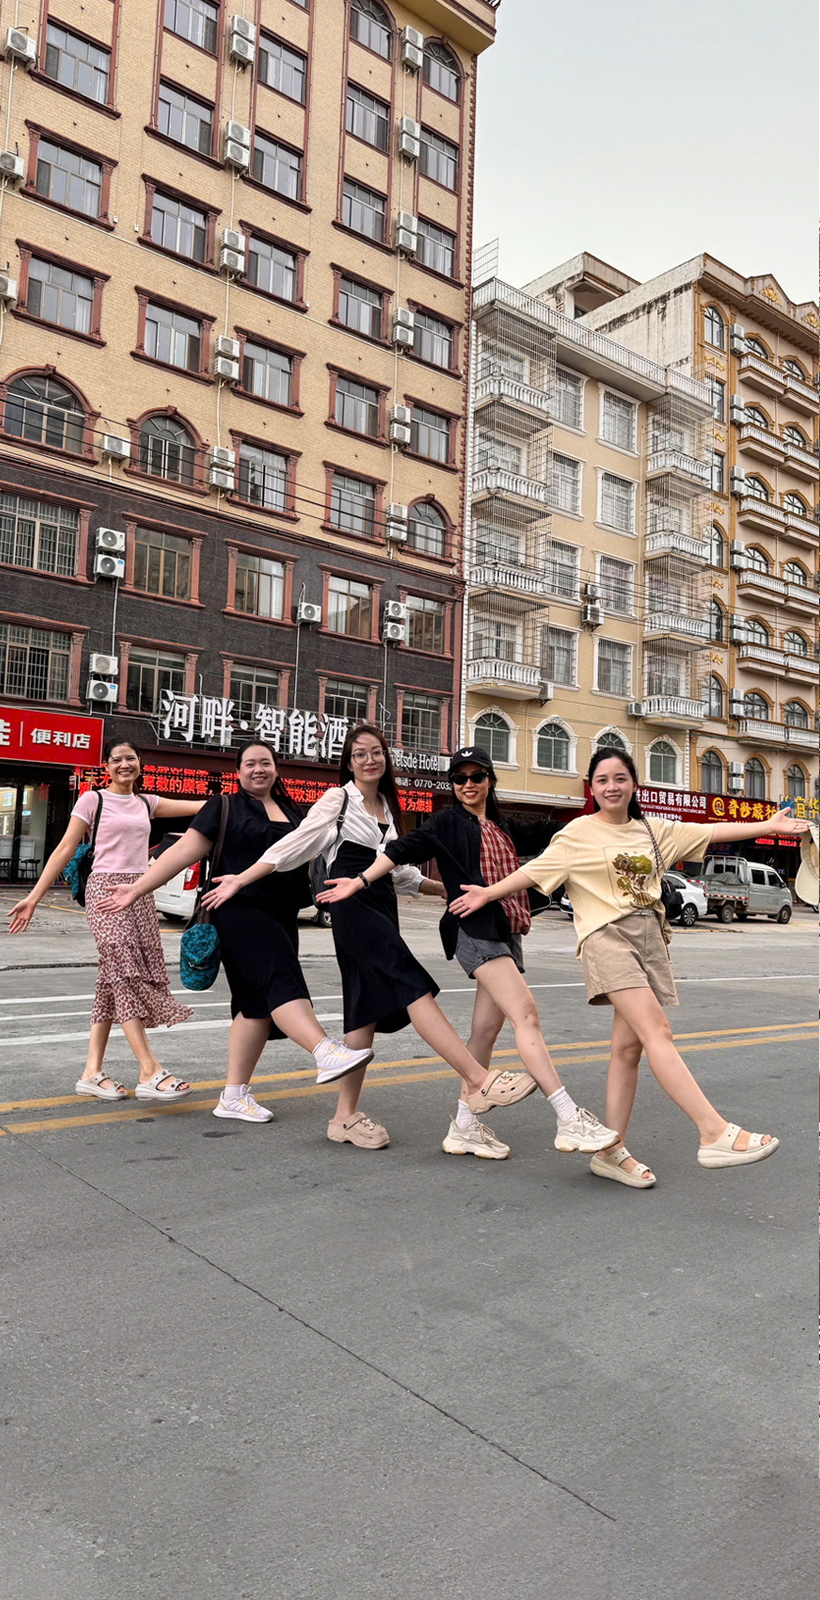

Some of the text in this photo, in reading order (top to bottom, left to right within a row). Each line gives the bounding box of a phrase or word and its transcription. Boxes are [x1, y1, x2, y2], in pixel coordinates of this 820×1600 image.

[161, 690, 368, 759] 河畔·智能酒
[30, 728, 91, 749] 便利店
[418, 753, 440, 771] Hotel
